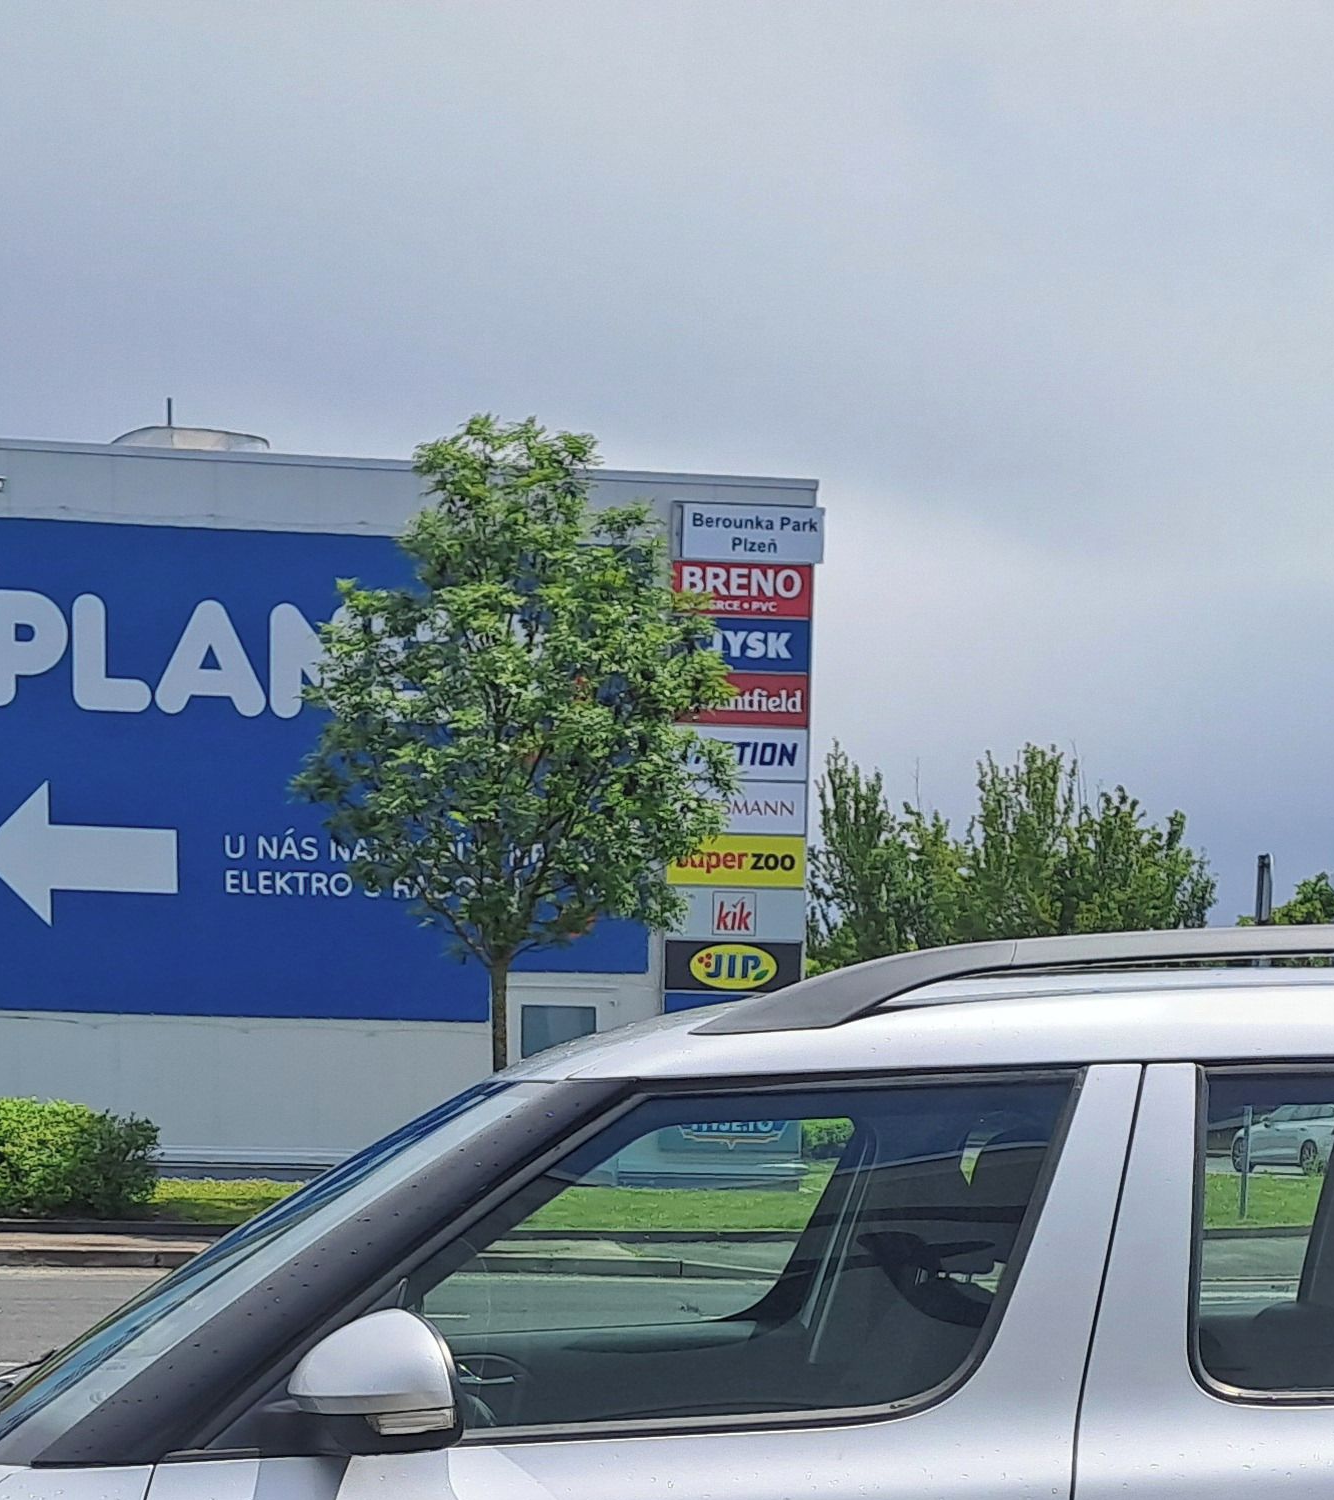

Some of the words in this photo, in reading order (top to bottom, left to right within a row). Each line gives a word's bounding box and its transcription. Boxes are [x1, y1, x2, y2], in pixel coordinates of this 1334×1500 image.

[692, 513, 774, 531] Berounka
[780, 517, 818, 533] Park
[731, 537, 777, 553] Plzeň
[681, 565, 803, 599] BRENO
[751, 601, 778, 612] PVC
[224, 834, 245, 860] U
[257, 828, 319, 862] NÁS
[224, 869, 353, 898] ELEKTRO
